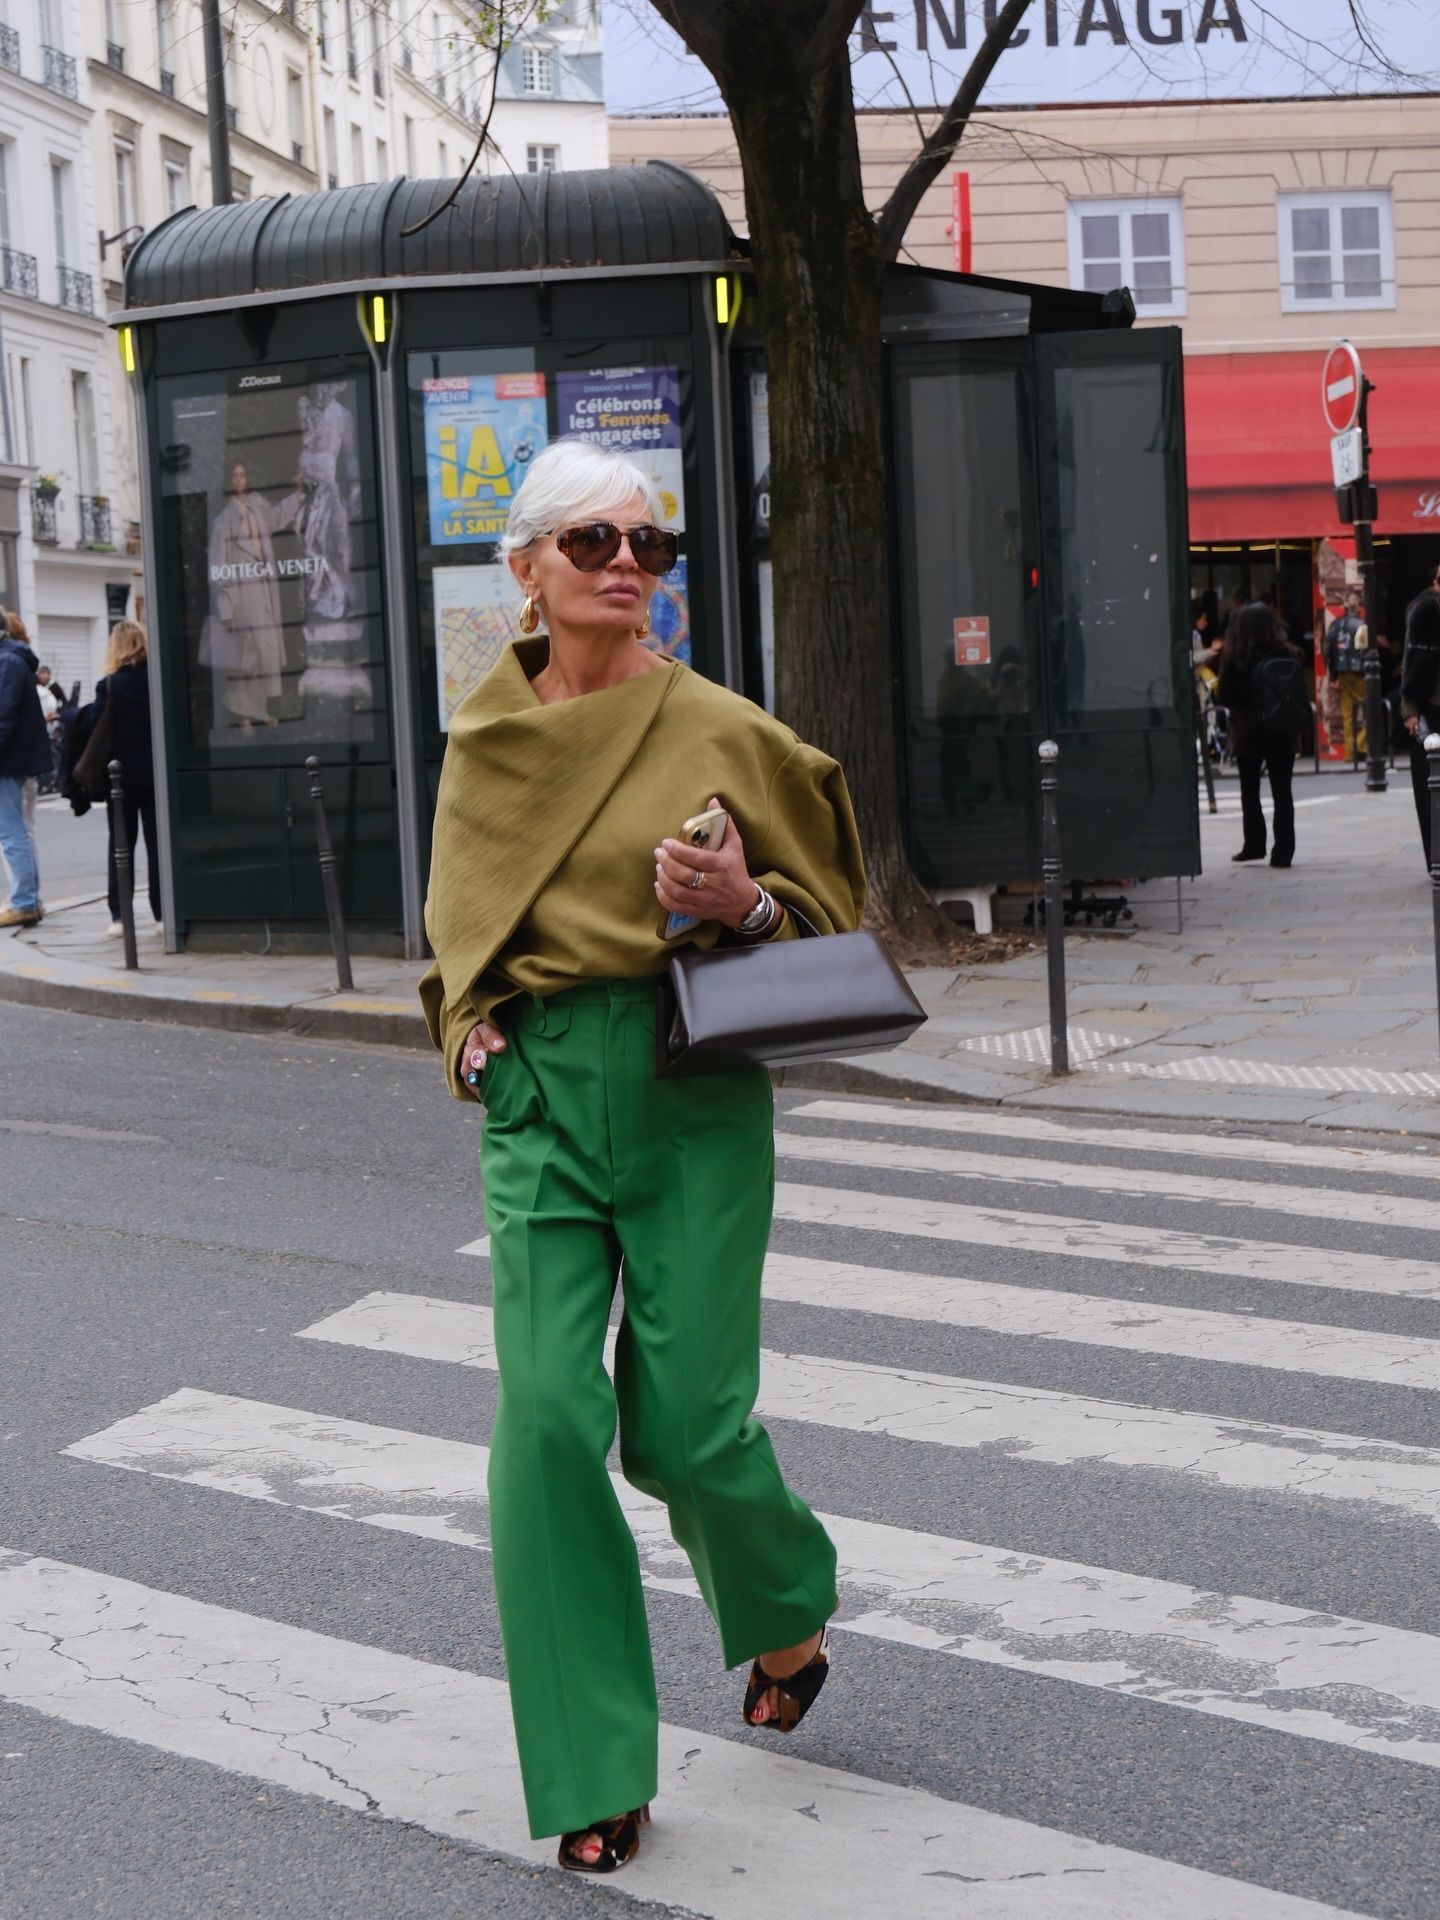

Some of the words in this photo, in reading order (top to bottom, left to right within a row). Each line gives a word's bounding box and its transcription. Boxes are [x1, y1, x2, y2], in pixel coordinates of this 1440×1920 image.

[428, 391, 469, 403] AVENIR
[575, 397, 663, 414] Célébrons
[569, 414, 595, 429] les
[599, 413, 670, 427] Femmes
[579, 426, 662, 446] engagées
[443, 521, 463, 537] LA
[465, 518, 508, 535] SANT
[211, 562, 273, 580] BOTTEGA
[277, 557, 329, 575] VENETA
